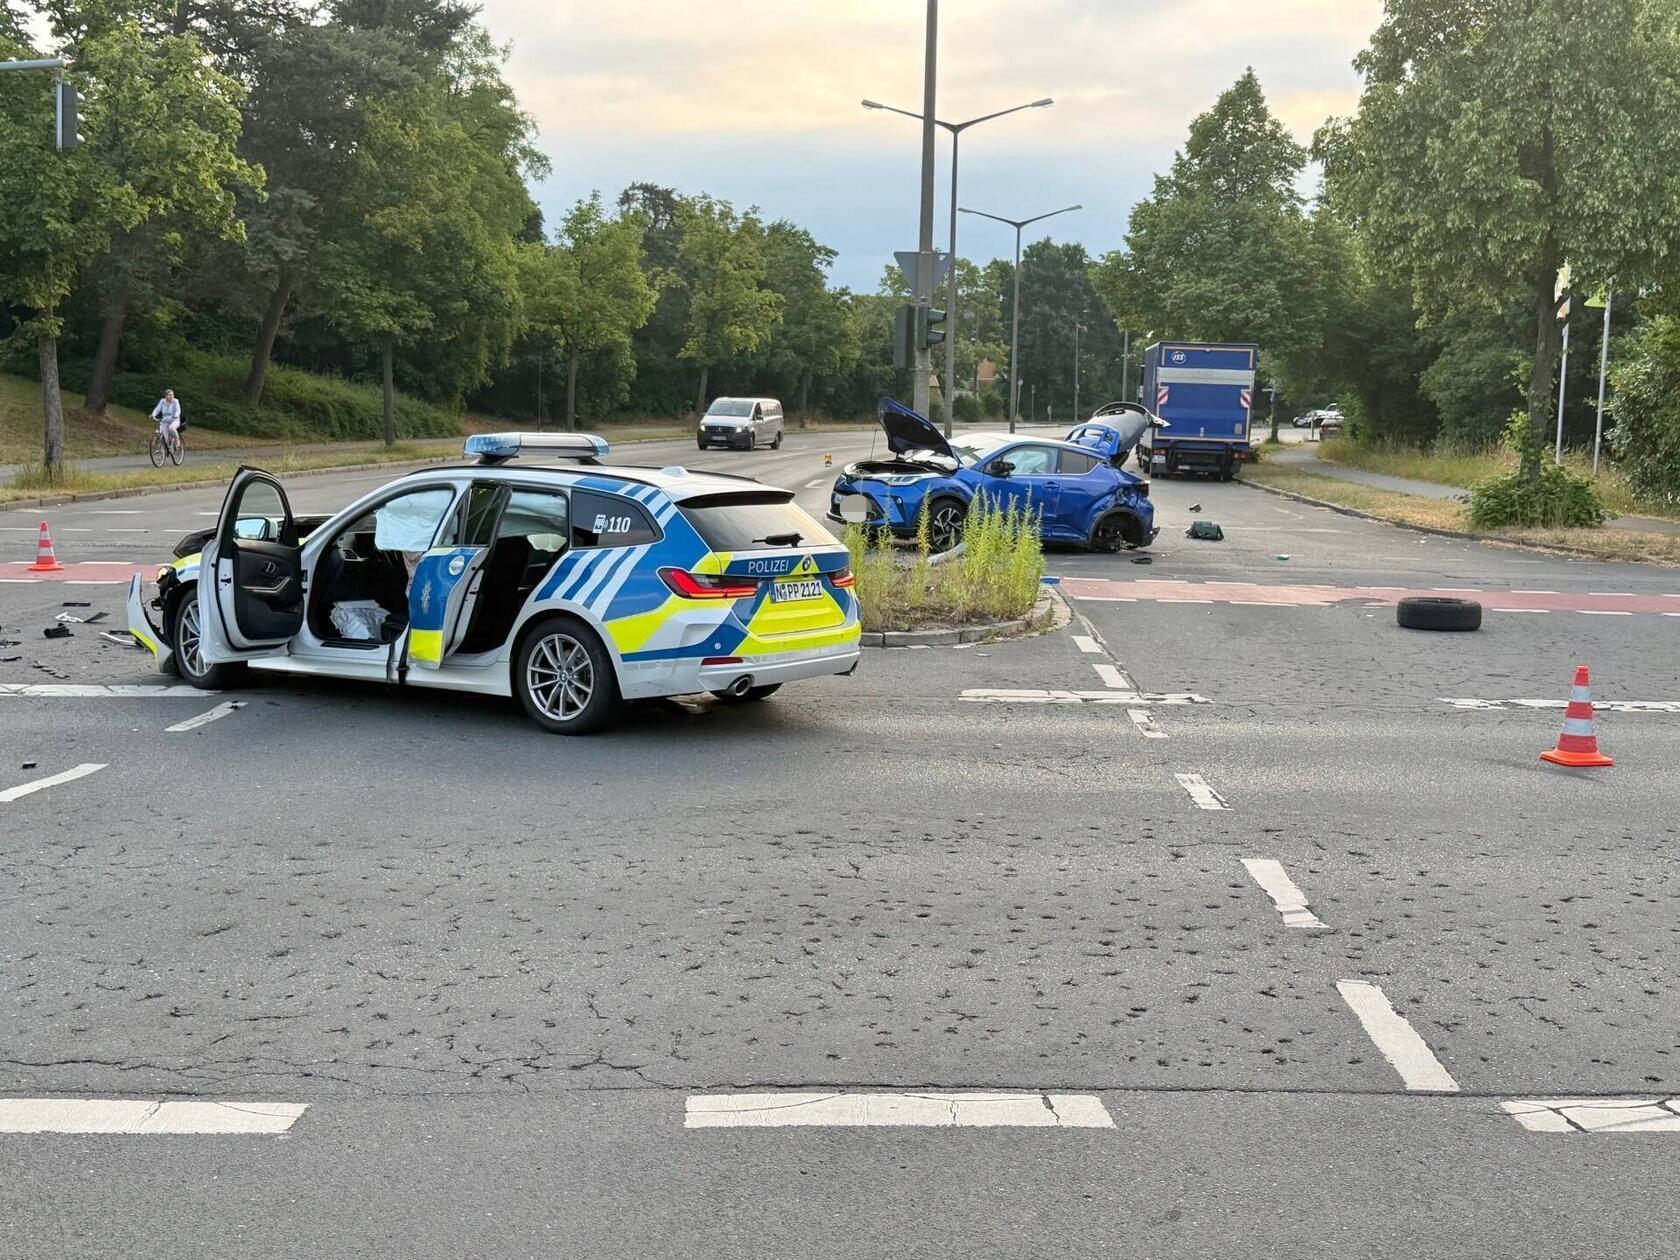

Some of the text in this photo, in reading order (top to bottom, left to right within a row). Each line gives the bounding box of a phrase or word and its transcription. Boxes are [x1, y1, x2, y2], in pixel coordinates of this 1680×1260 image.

[607, 516, 631, 533] 110
[748, 560, 789, 573] POLIZEI
[776, 581, 822, 599] N PP 2121
